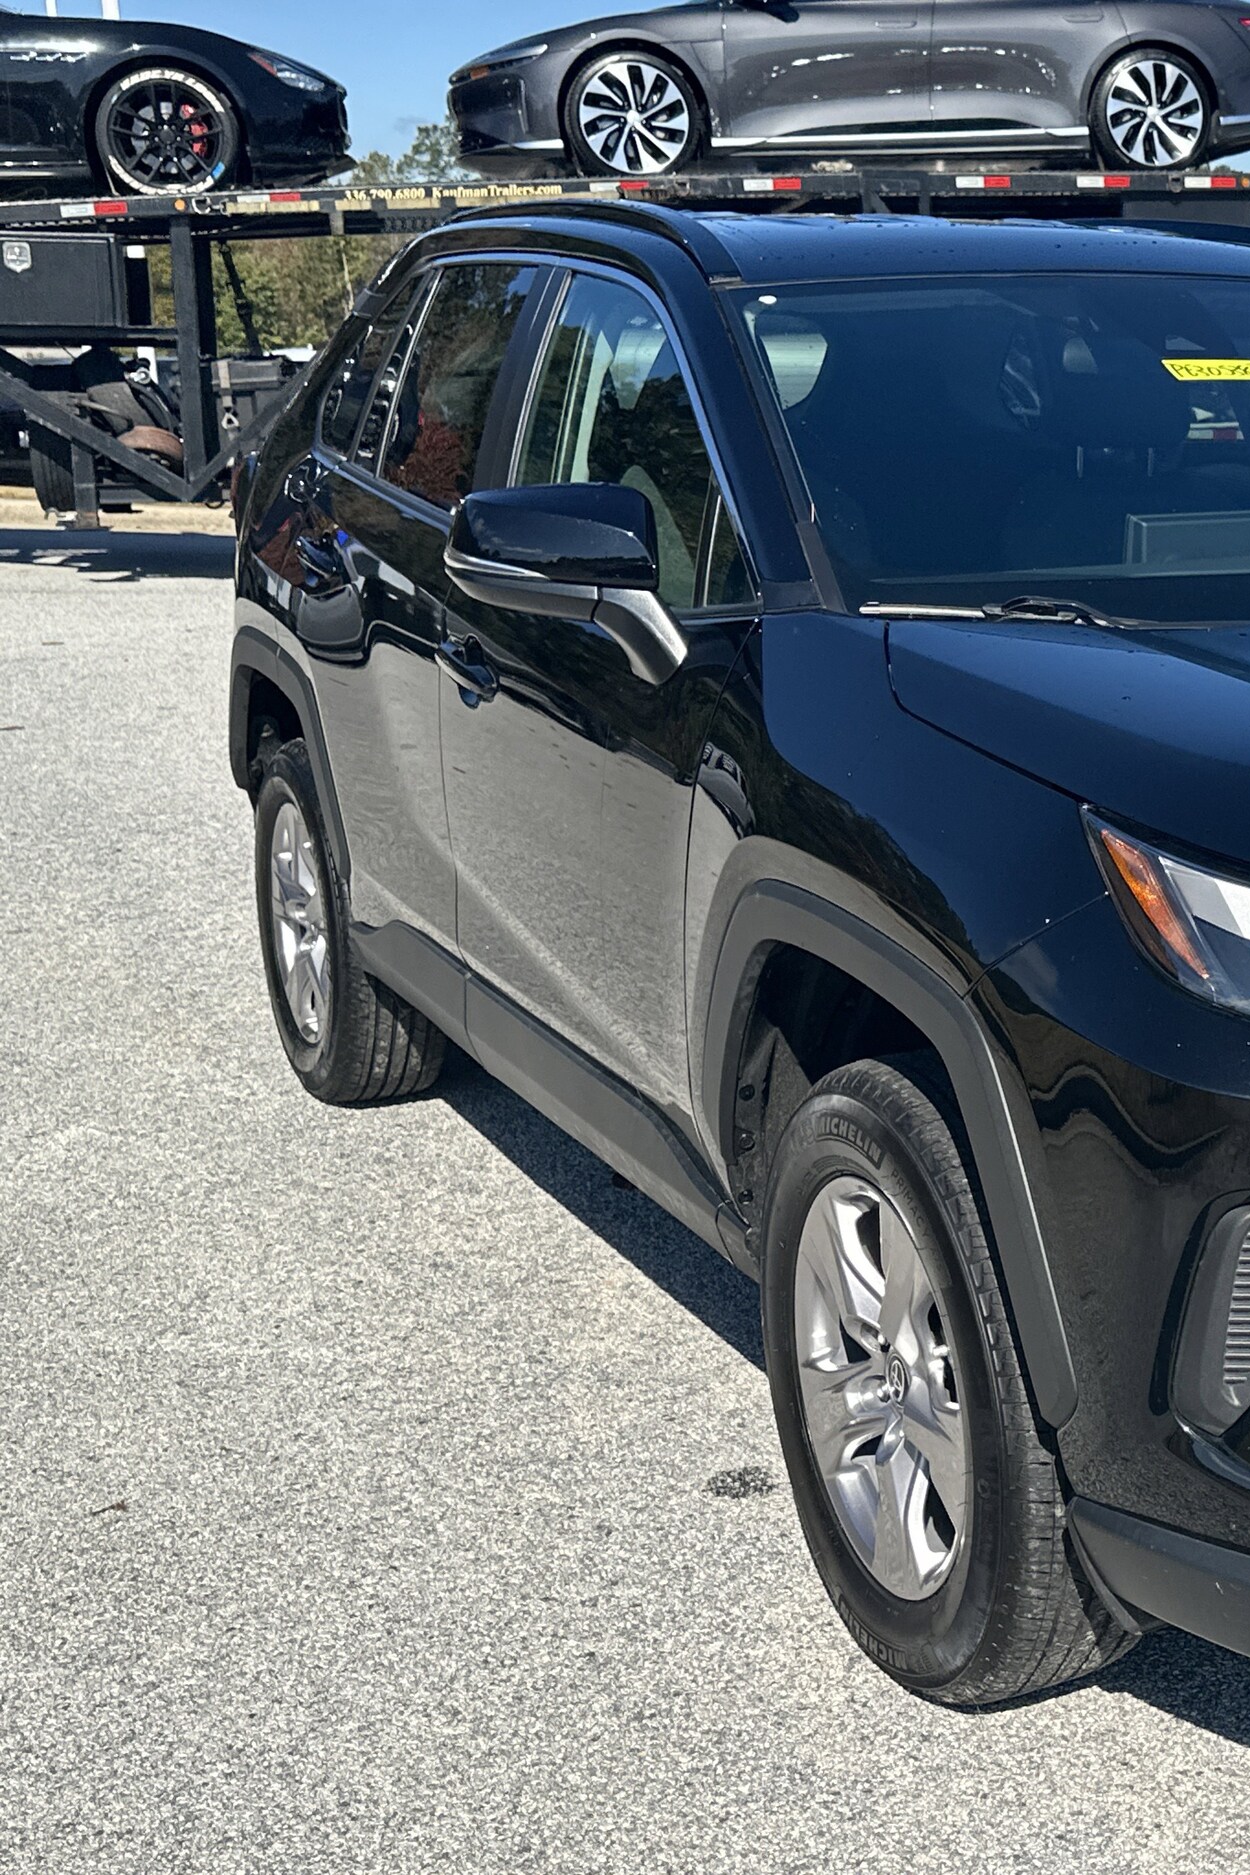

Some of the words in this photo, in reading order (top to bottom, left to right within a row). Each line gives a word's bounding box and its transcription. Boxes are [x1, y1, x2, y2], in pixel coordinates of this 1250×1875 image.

[432, 184, 562, 199] KaufmanTrailers.com
[818, 1114, 883, 1163] MICHELIN
[890, 1168, 930, 1237] PRIMACY
[839, 1600, 908, 1670] MICHELIN
